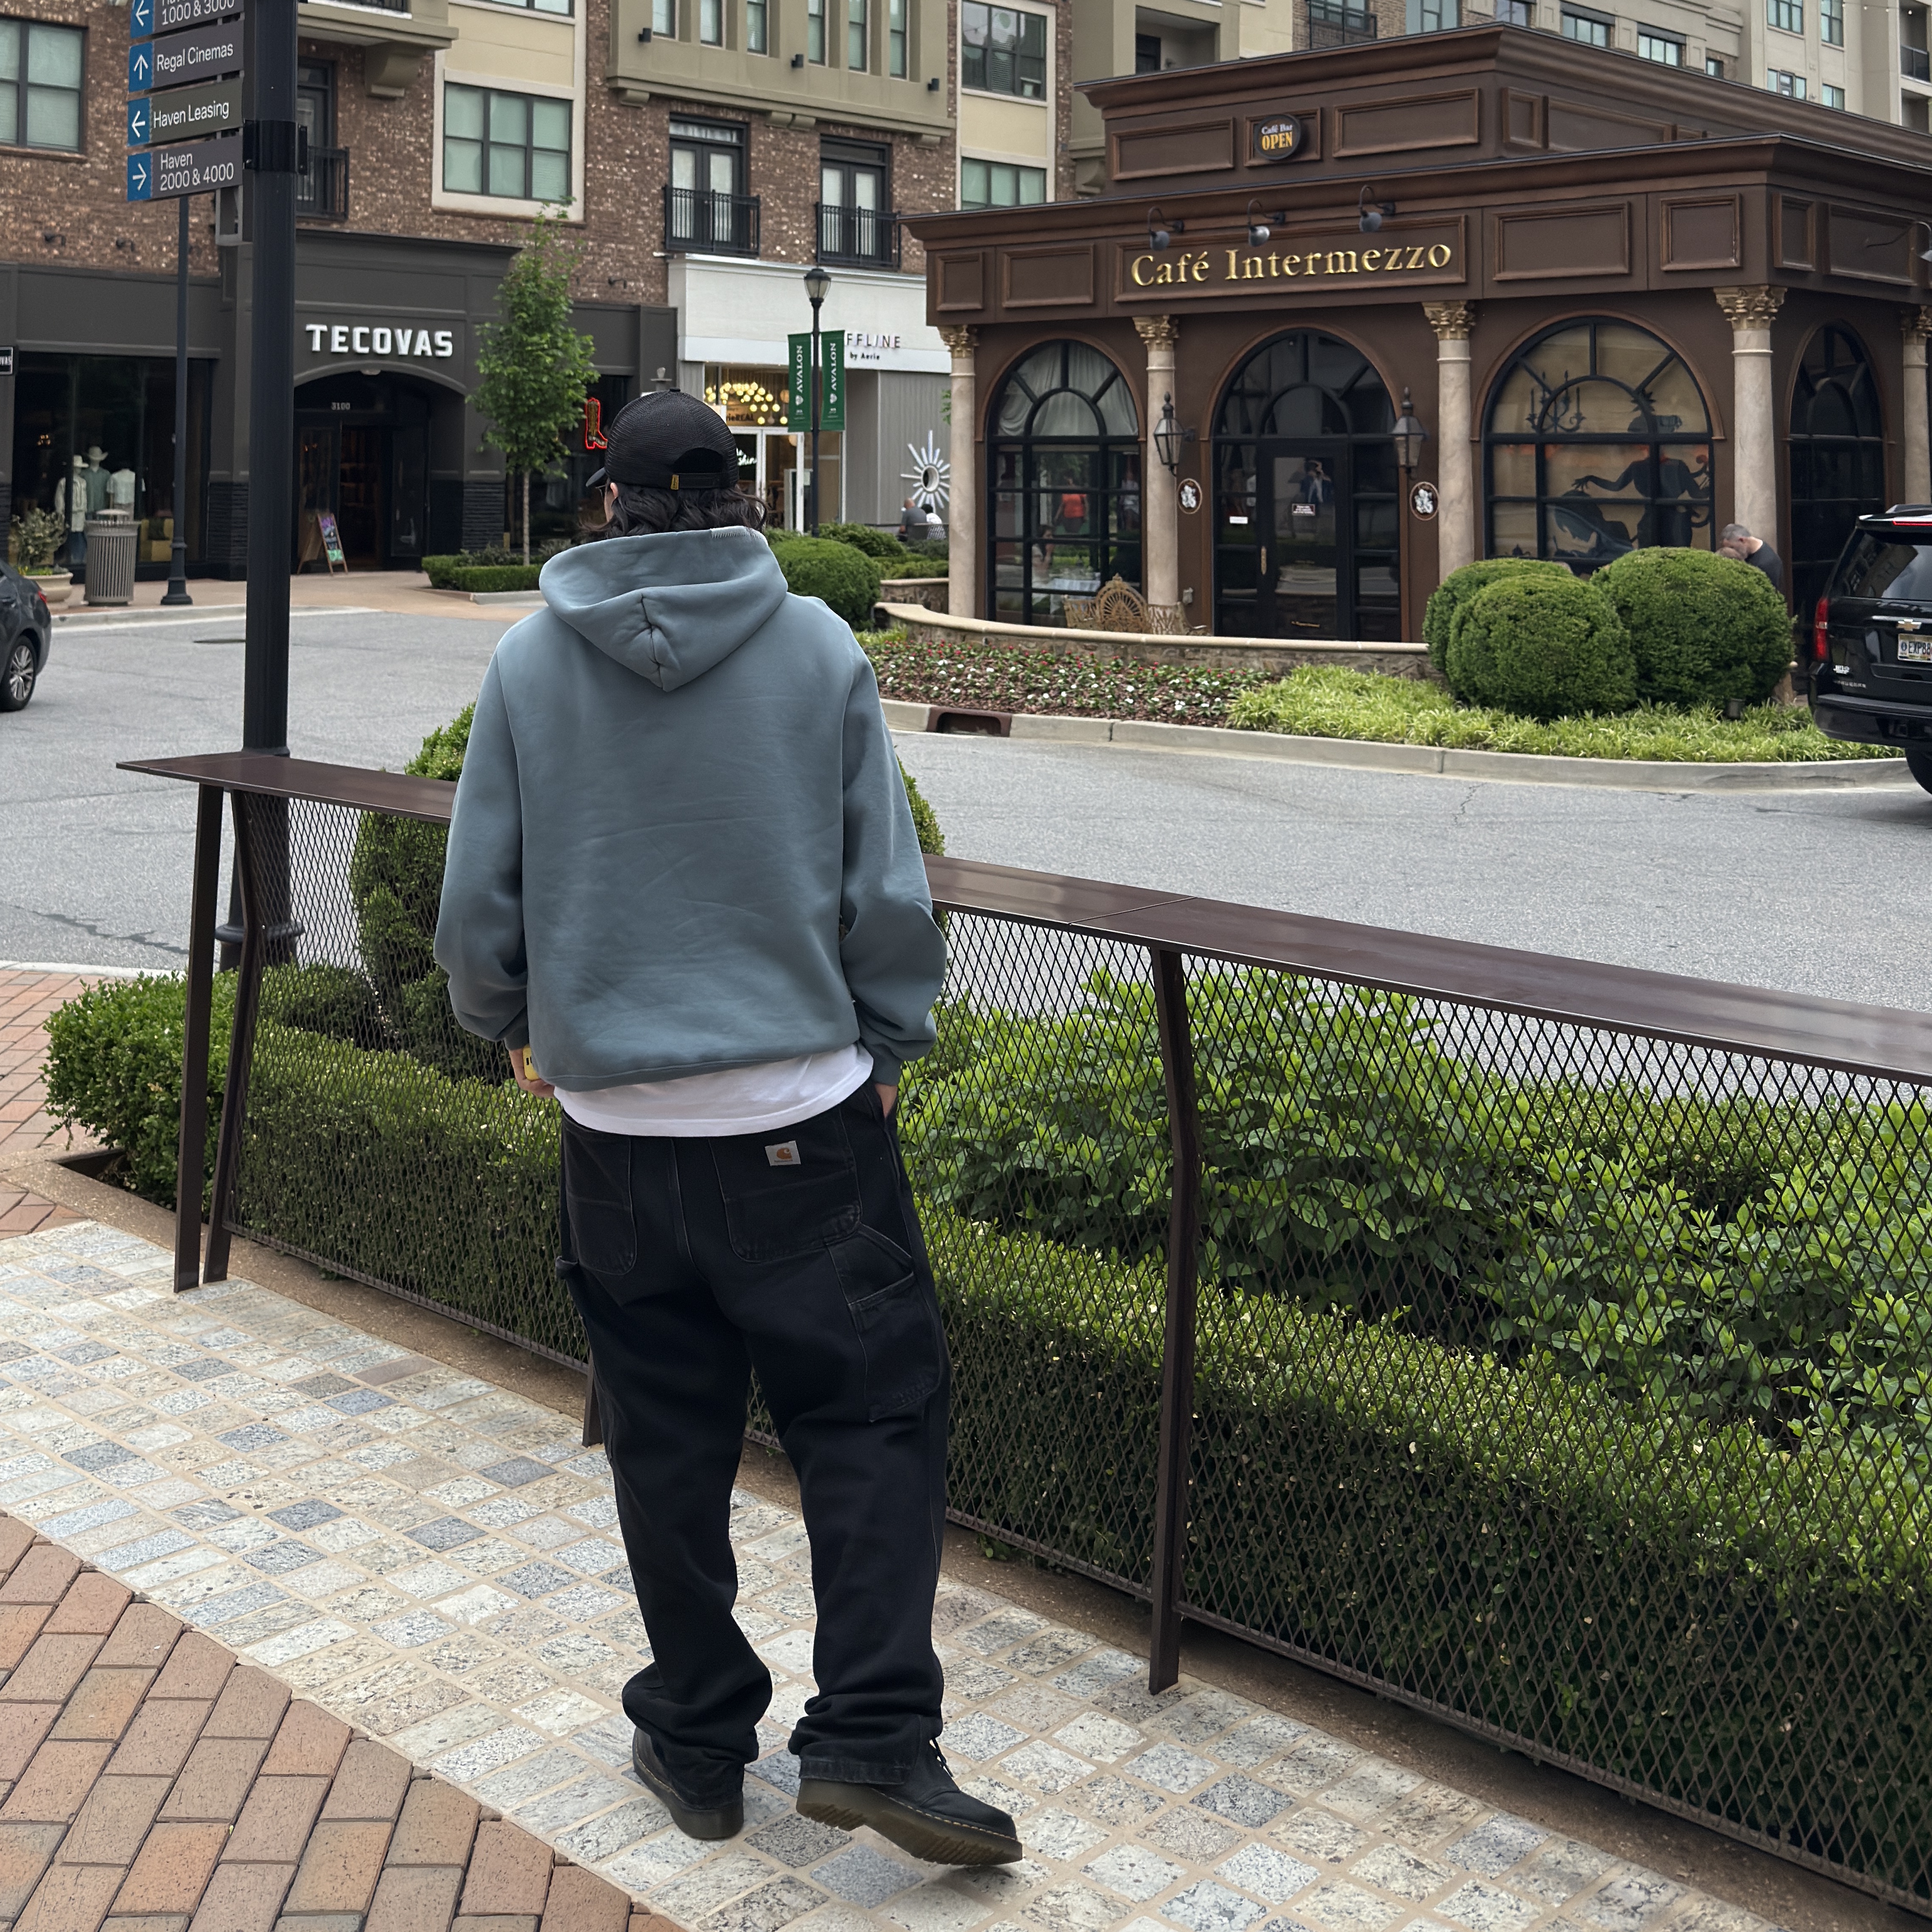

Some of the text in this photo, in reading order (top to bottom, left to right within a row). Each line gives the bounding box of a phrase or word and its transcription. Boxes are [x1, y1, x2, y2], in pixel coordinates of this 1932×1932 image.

[162, 3, 191, 25] 1000
[194, 0, 201, 17] &
[157, 43, 233, 72] Regal Cinemas
[153, 100, 229, 128] Haven Leasing
[1262, 131, 1292, 150] OPEN
[161, 153, 193, 171] Haven
[160, 162, 234, 191] 2000 & 4000
[1131, 244, 1451, 286] Café Intermezzo
[305, 324, 453, 357] TECOVAS
[847, 333, 901, 349] FFLINE
[850, 352, 857, 361] by
